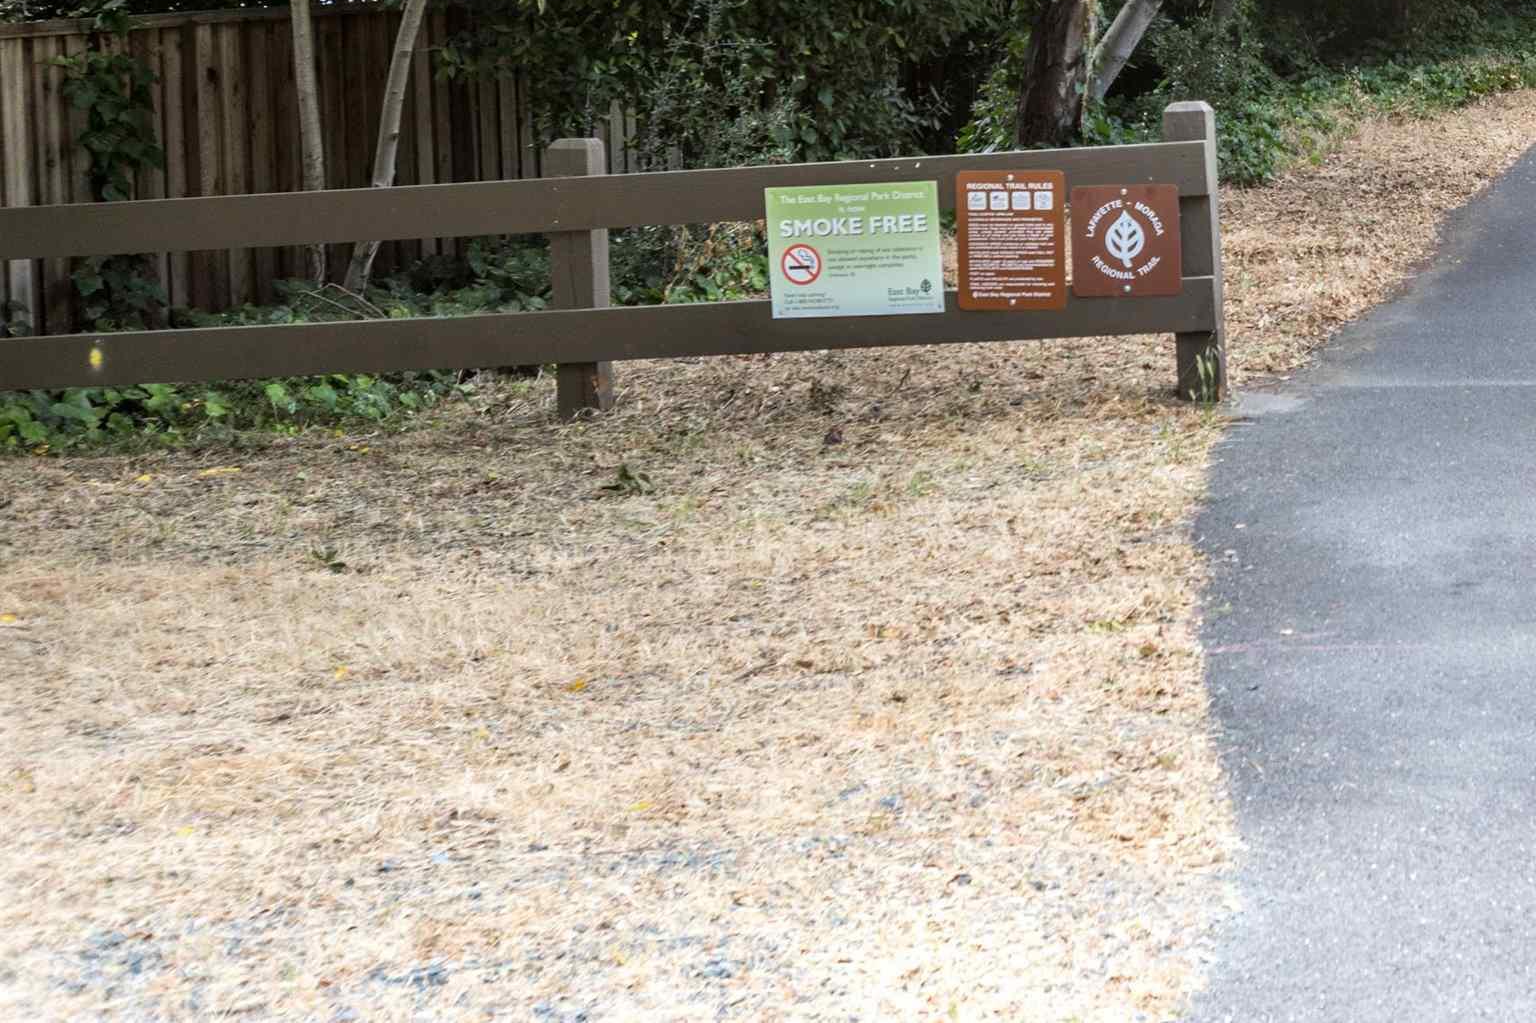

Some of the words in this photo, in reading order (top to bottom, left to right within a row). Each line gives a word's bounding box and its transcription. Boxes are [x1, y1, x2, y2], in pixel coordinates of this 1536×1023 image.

[779, 217, 863, 238] SMOKE
[870, 213, 928, 234] FREE
[1085, 199, 1122, 237] LAFAYETTE
[1134, 201, 1164, 237] MORAGA
[1091, 255, 1136, 280] REGIONAL
[1137, 256, 1161, 276] TRAIL
